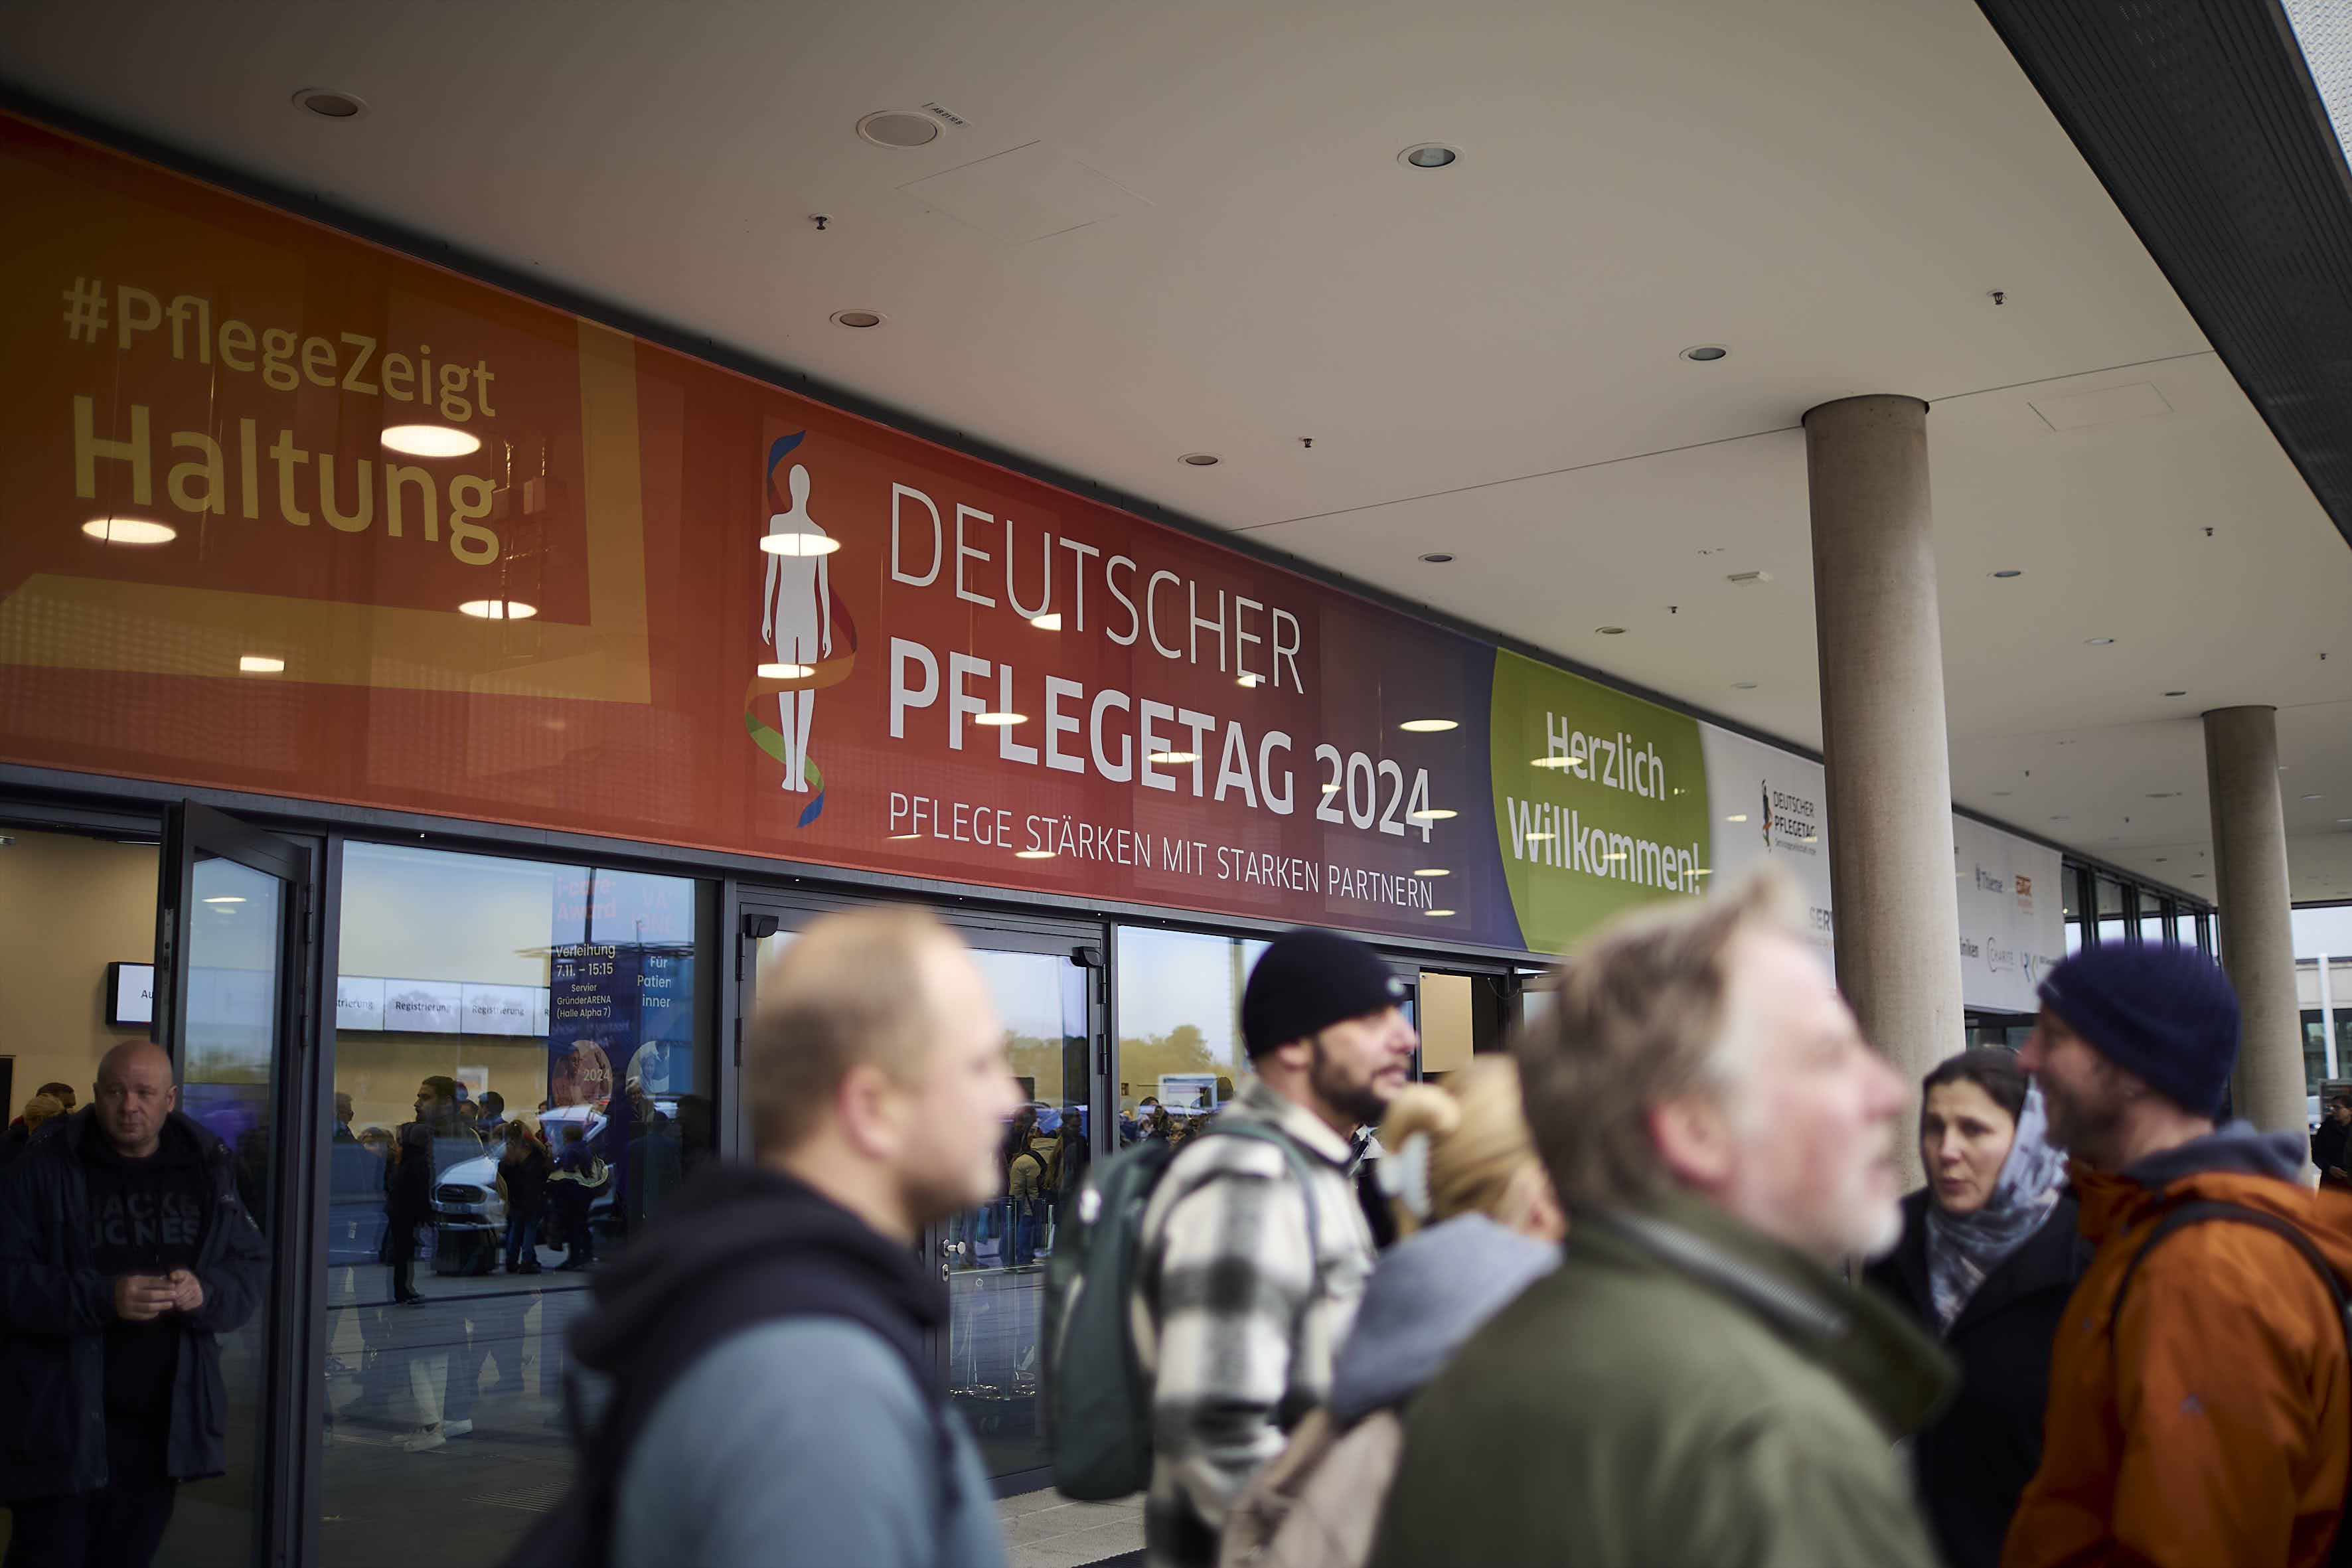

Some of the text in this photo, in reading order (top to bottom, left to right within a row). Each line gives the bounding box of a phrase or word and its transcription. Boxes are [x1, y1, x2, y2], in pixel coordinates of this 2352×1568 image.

[62, 276, 496, 422] #PflegeZeigt
[73, 395, 499, 566] Haltung
[891, 481, 1305, 695] DEUTSCHER
[890, 636, 1435, 844] PFLEGETAG 2024
[1547, 712, 1666, 801] Herzlich
[1773, 791, 1815, 819] DEUTSCHER
[1774, 815, 1816, 838] PFLEGETAG
[890, 791, 1434, 909] PFLEGE STÄRKEN MIT STARKEN PARTNERN
[1506, 796, 1700, 896] Willkommen!
[556, 943, 616, 959] Verleihung
[651, 956, 668, 969] Für
[556, 964, 576, 977] 7.11.
[588, 963, 613, 976] 15:15
[571, 982, 597, 992] Servier
[556, 995, 612, 1006] GründerARENA
[556, 1004, 611, 1020] (Halle Alpha 7)
[584, 1069, 611, 1082] 2024
